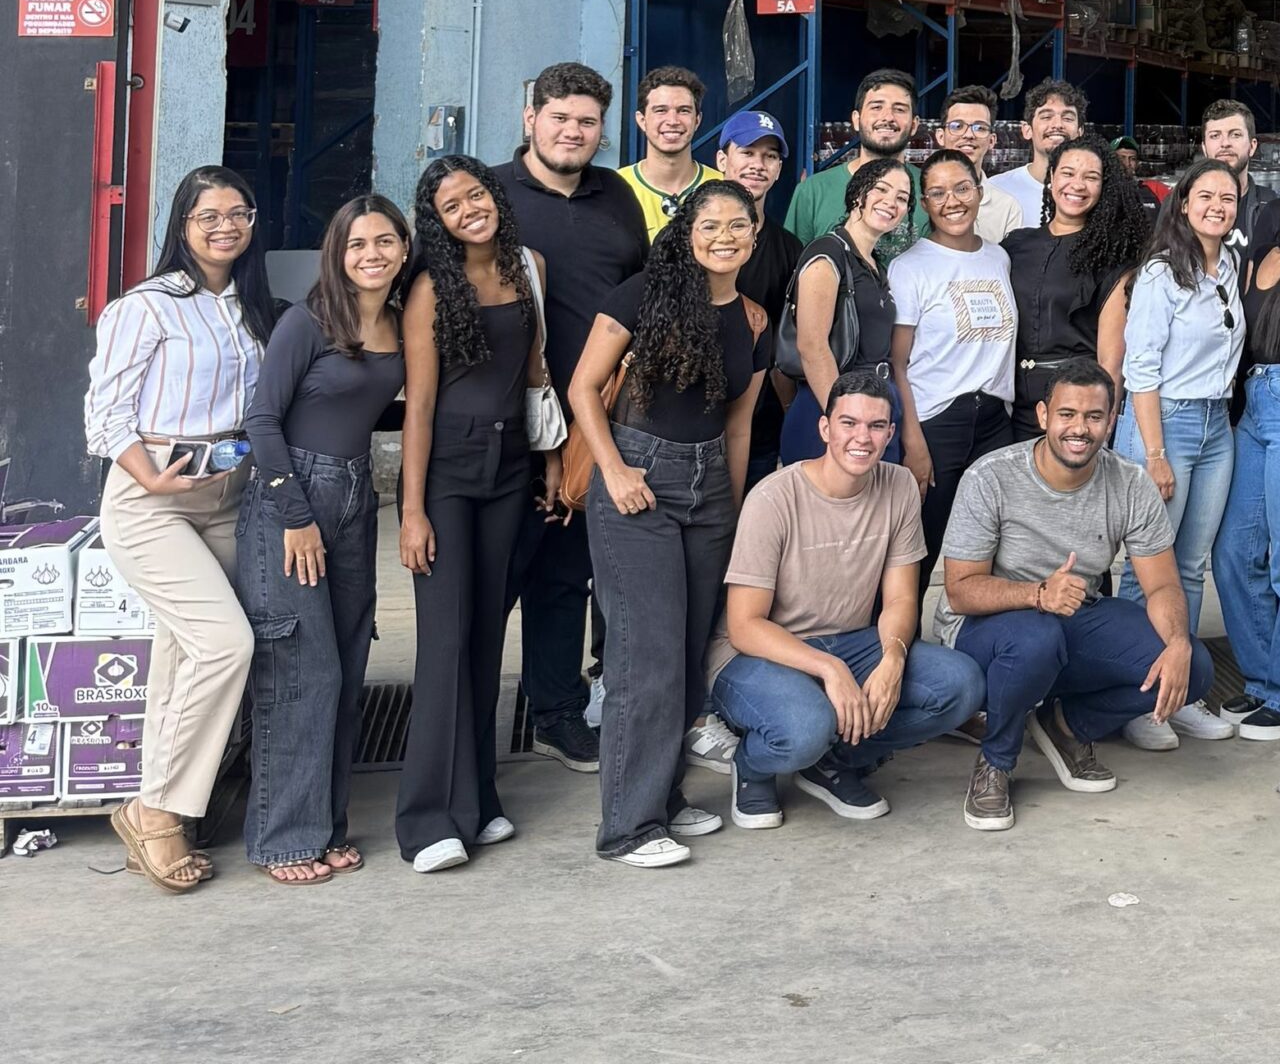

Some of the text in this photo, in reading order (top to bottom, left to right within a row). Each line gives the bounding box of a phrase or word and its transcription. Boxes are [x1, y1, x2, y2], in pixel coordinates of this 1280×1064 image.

[28, 2, 71, 12] FUMAR
[777, 0, 796, 12] 5A
[758, 113, 774, 130] LA
[118, 599, 127, 613] 4
[27, 730, 37, 744] 4
